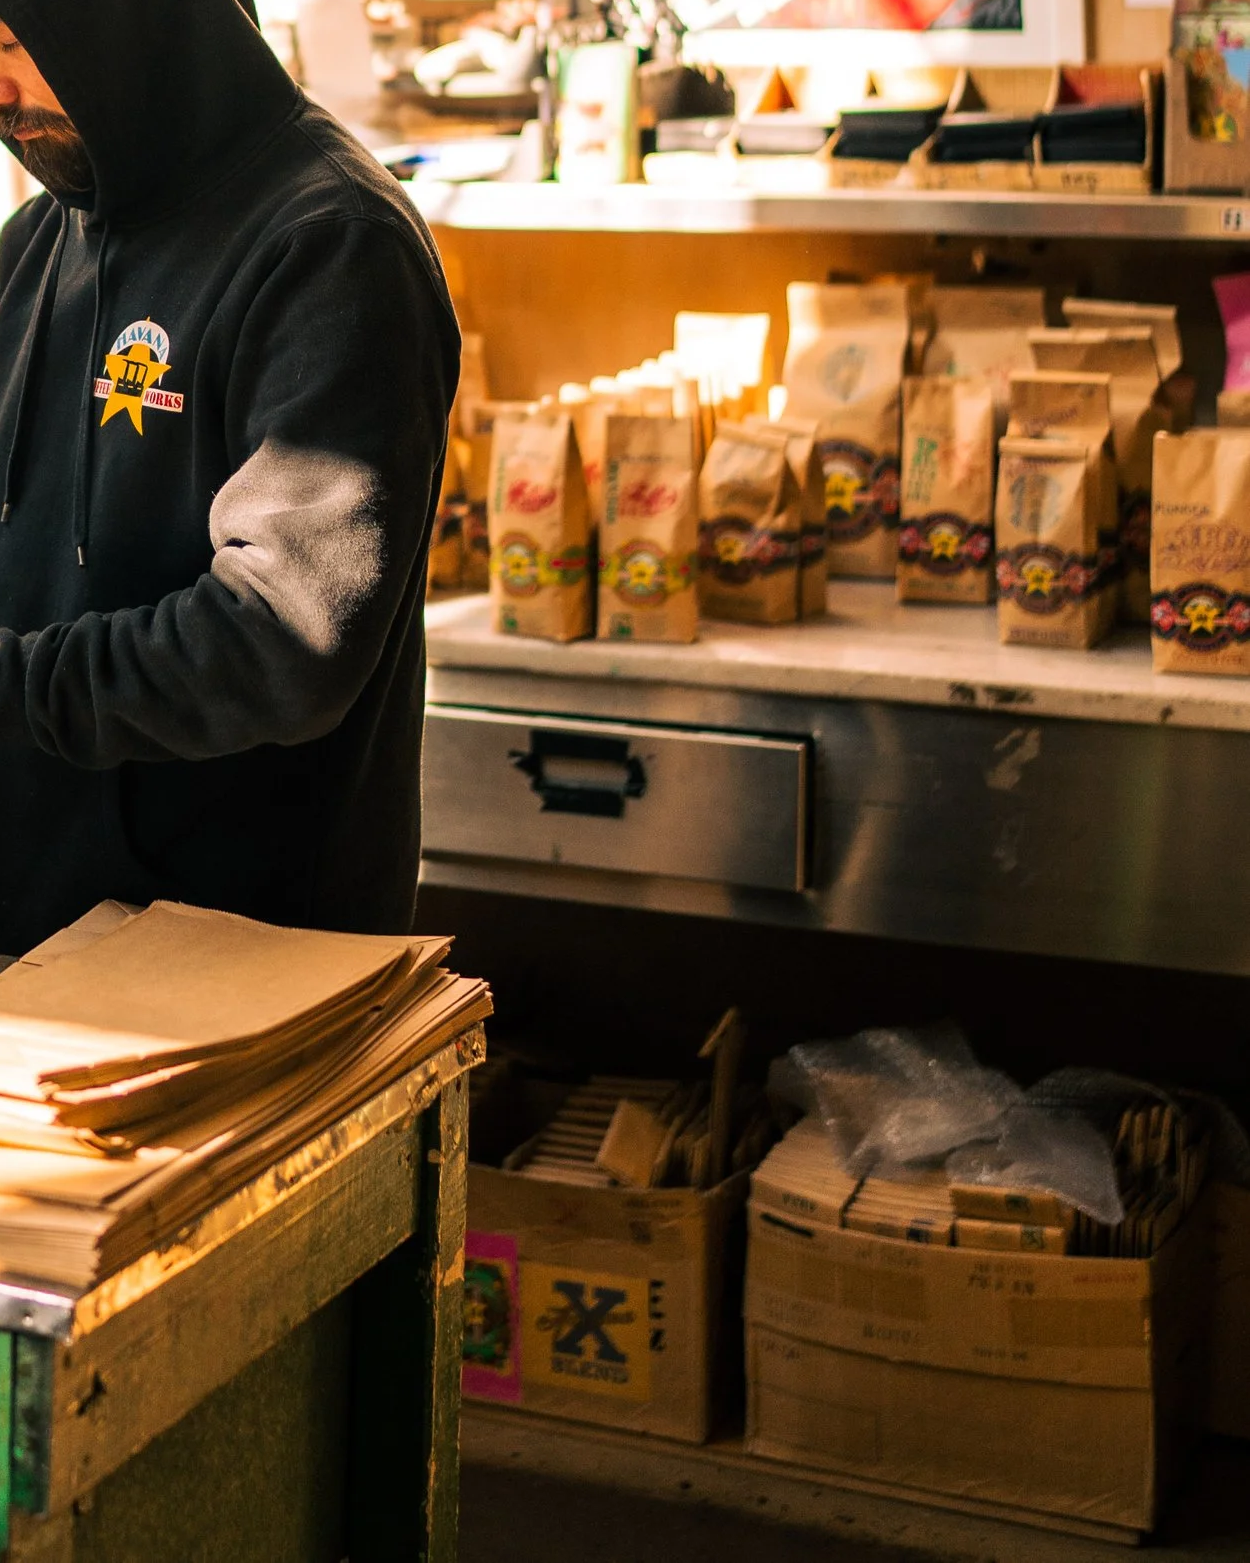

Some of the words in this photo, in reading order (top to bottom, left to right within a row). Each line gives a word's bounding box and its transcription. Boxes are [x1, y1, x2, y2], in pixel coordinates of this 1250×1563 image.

[116, 326, 168, 359] HAVANA
[94, 380, 111, 395] FFEE
[144, 390, 183, 410] WORKS
[554, 1280, 627, 1363] X
